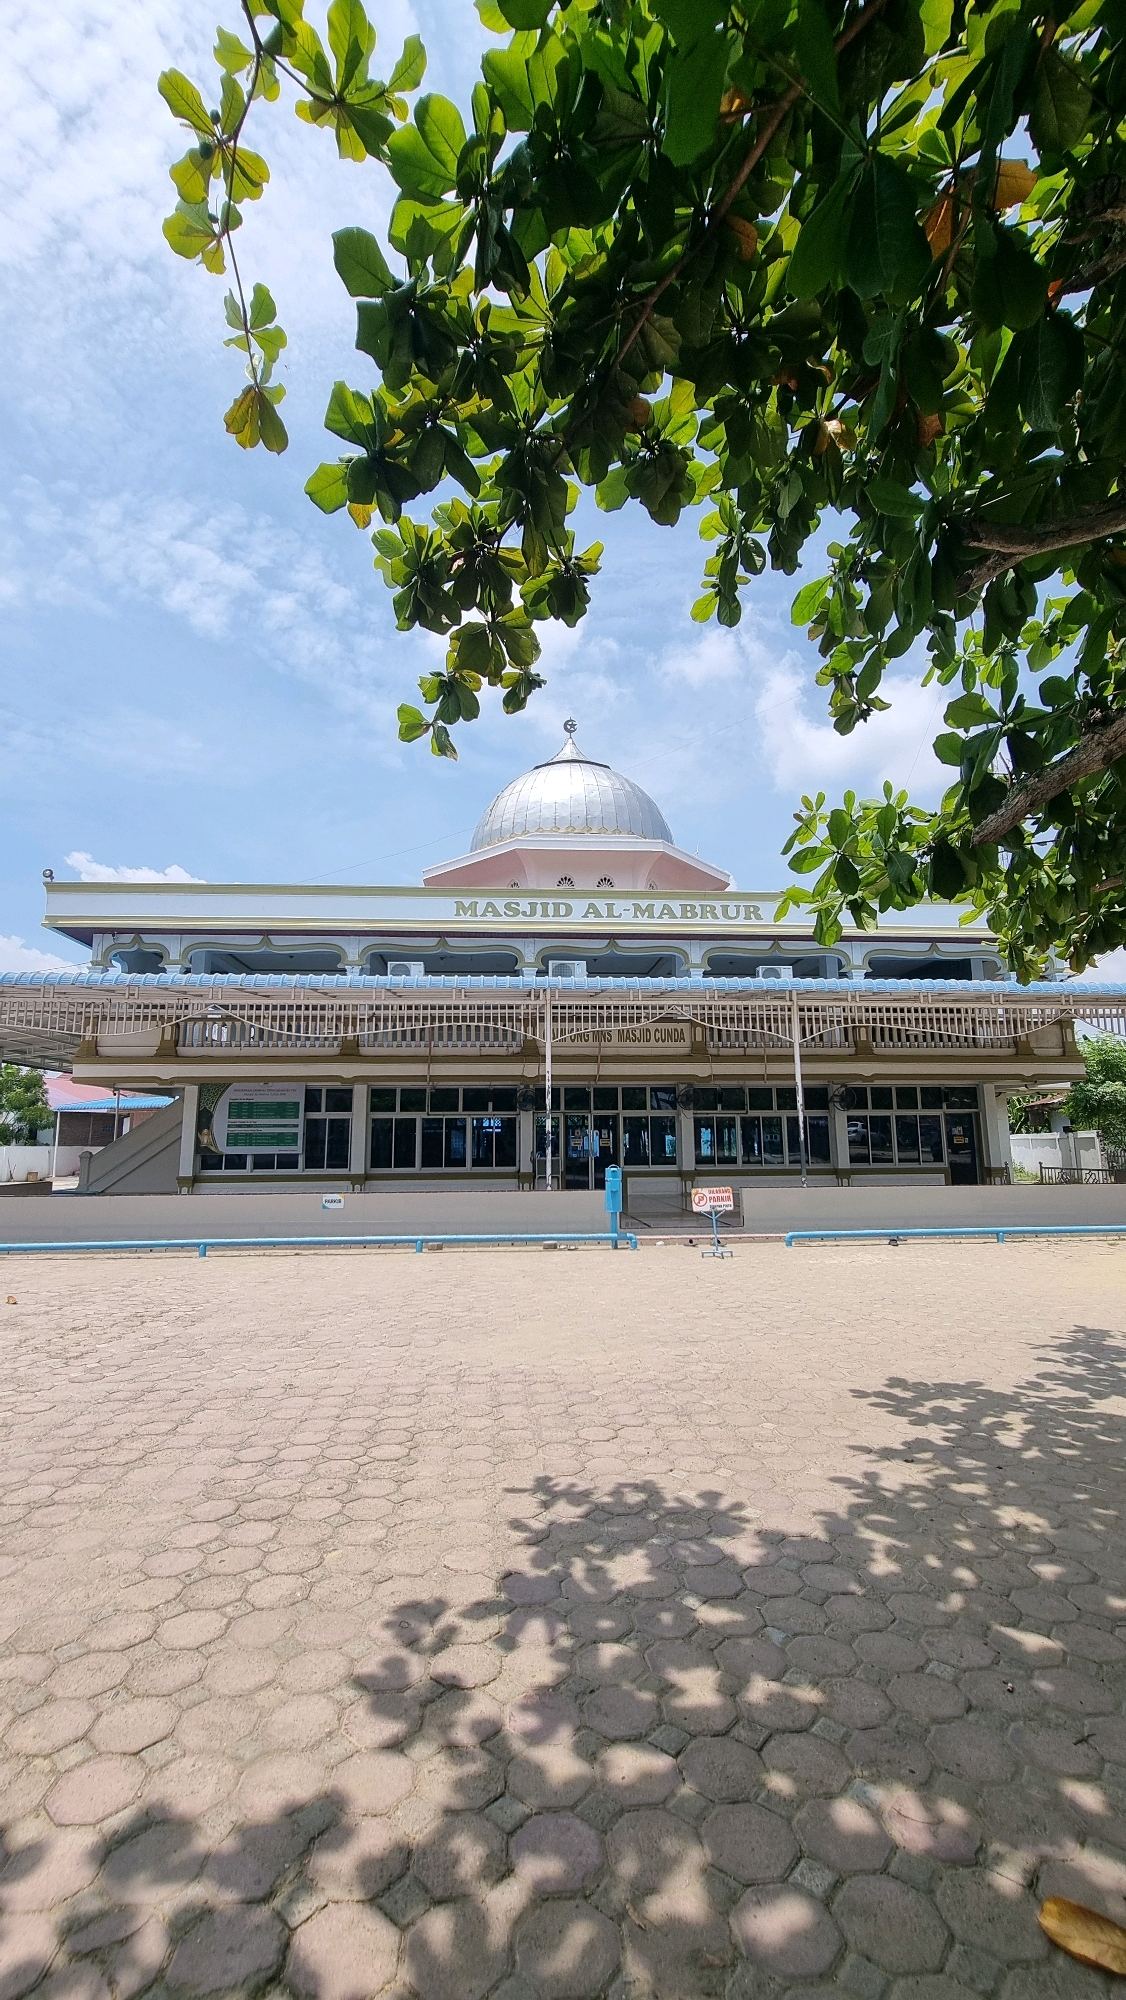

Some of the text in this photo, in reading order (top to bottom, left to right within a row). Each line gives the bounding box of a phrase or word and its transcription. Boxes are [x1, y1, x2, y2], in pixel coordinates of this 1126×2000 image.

[454, 900, 763, 921] MASJID AL-MABRUR
[543, 1028, 686, 1043] AMONG MNS MASJID CUNDA
